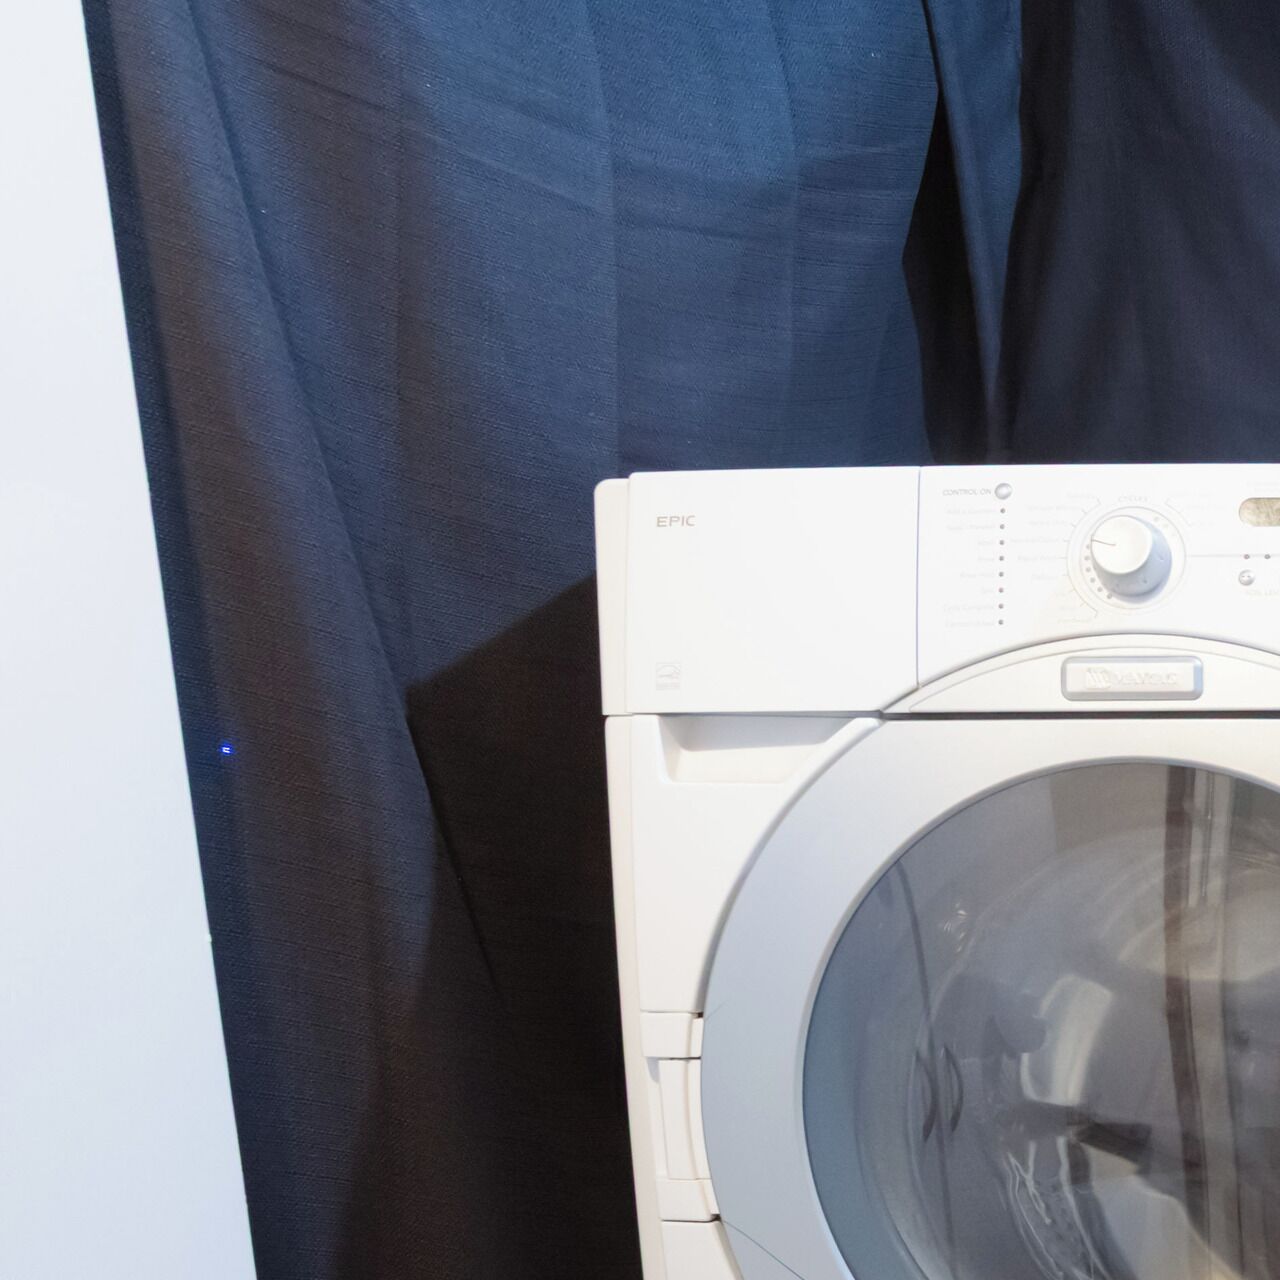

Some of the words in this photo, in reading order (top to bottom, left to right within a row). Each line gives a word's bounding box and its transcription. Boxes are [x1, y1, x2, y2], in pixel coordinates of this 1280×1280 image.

[942, 488, 978, 497] CONTROL
[979, 487, 992, 496] ON
[656, 515, 696, 528] EPIC
